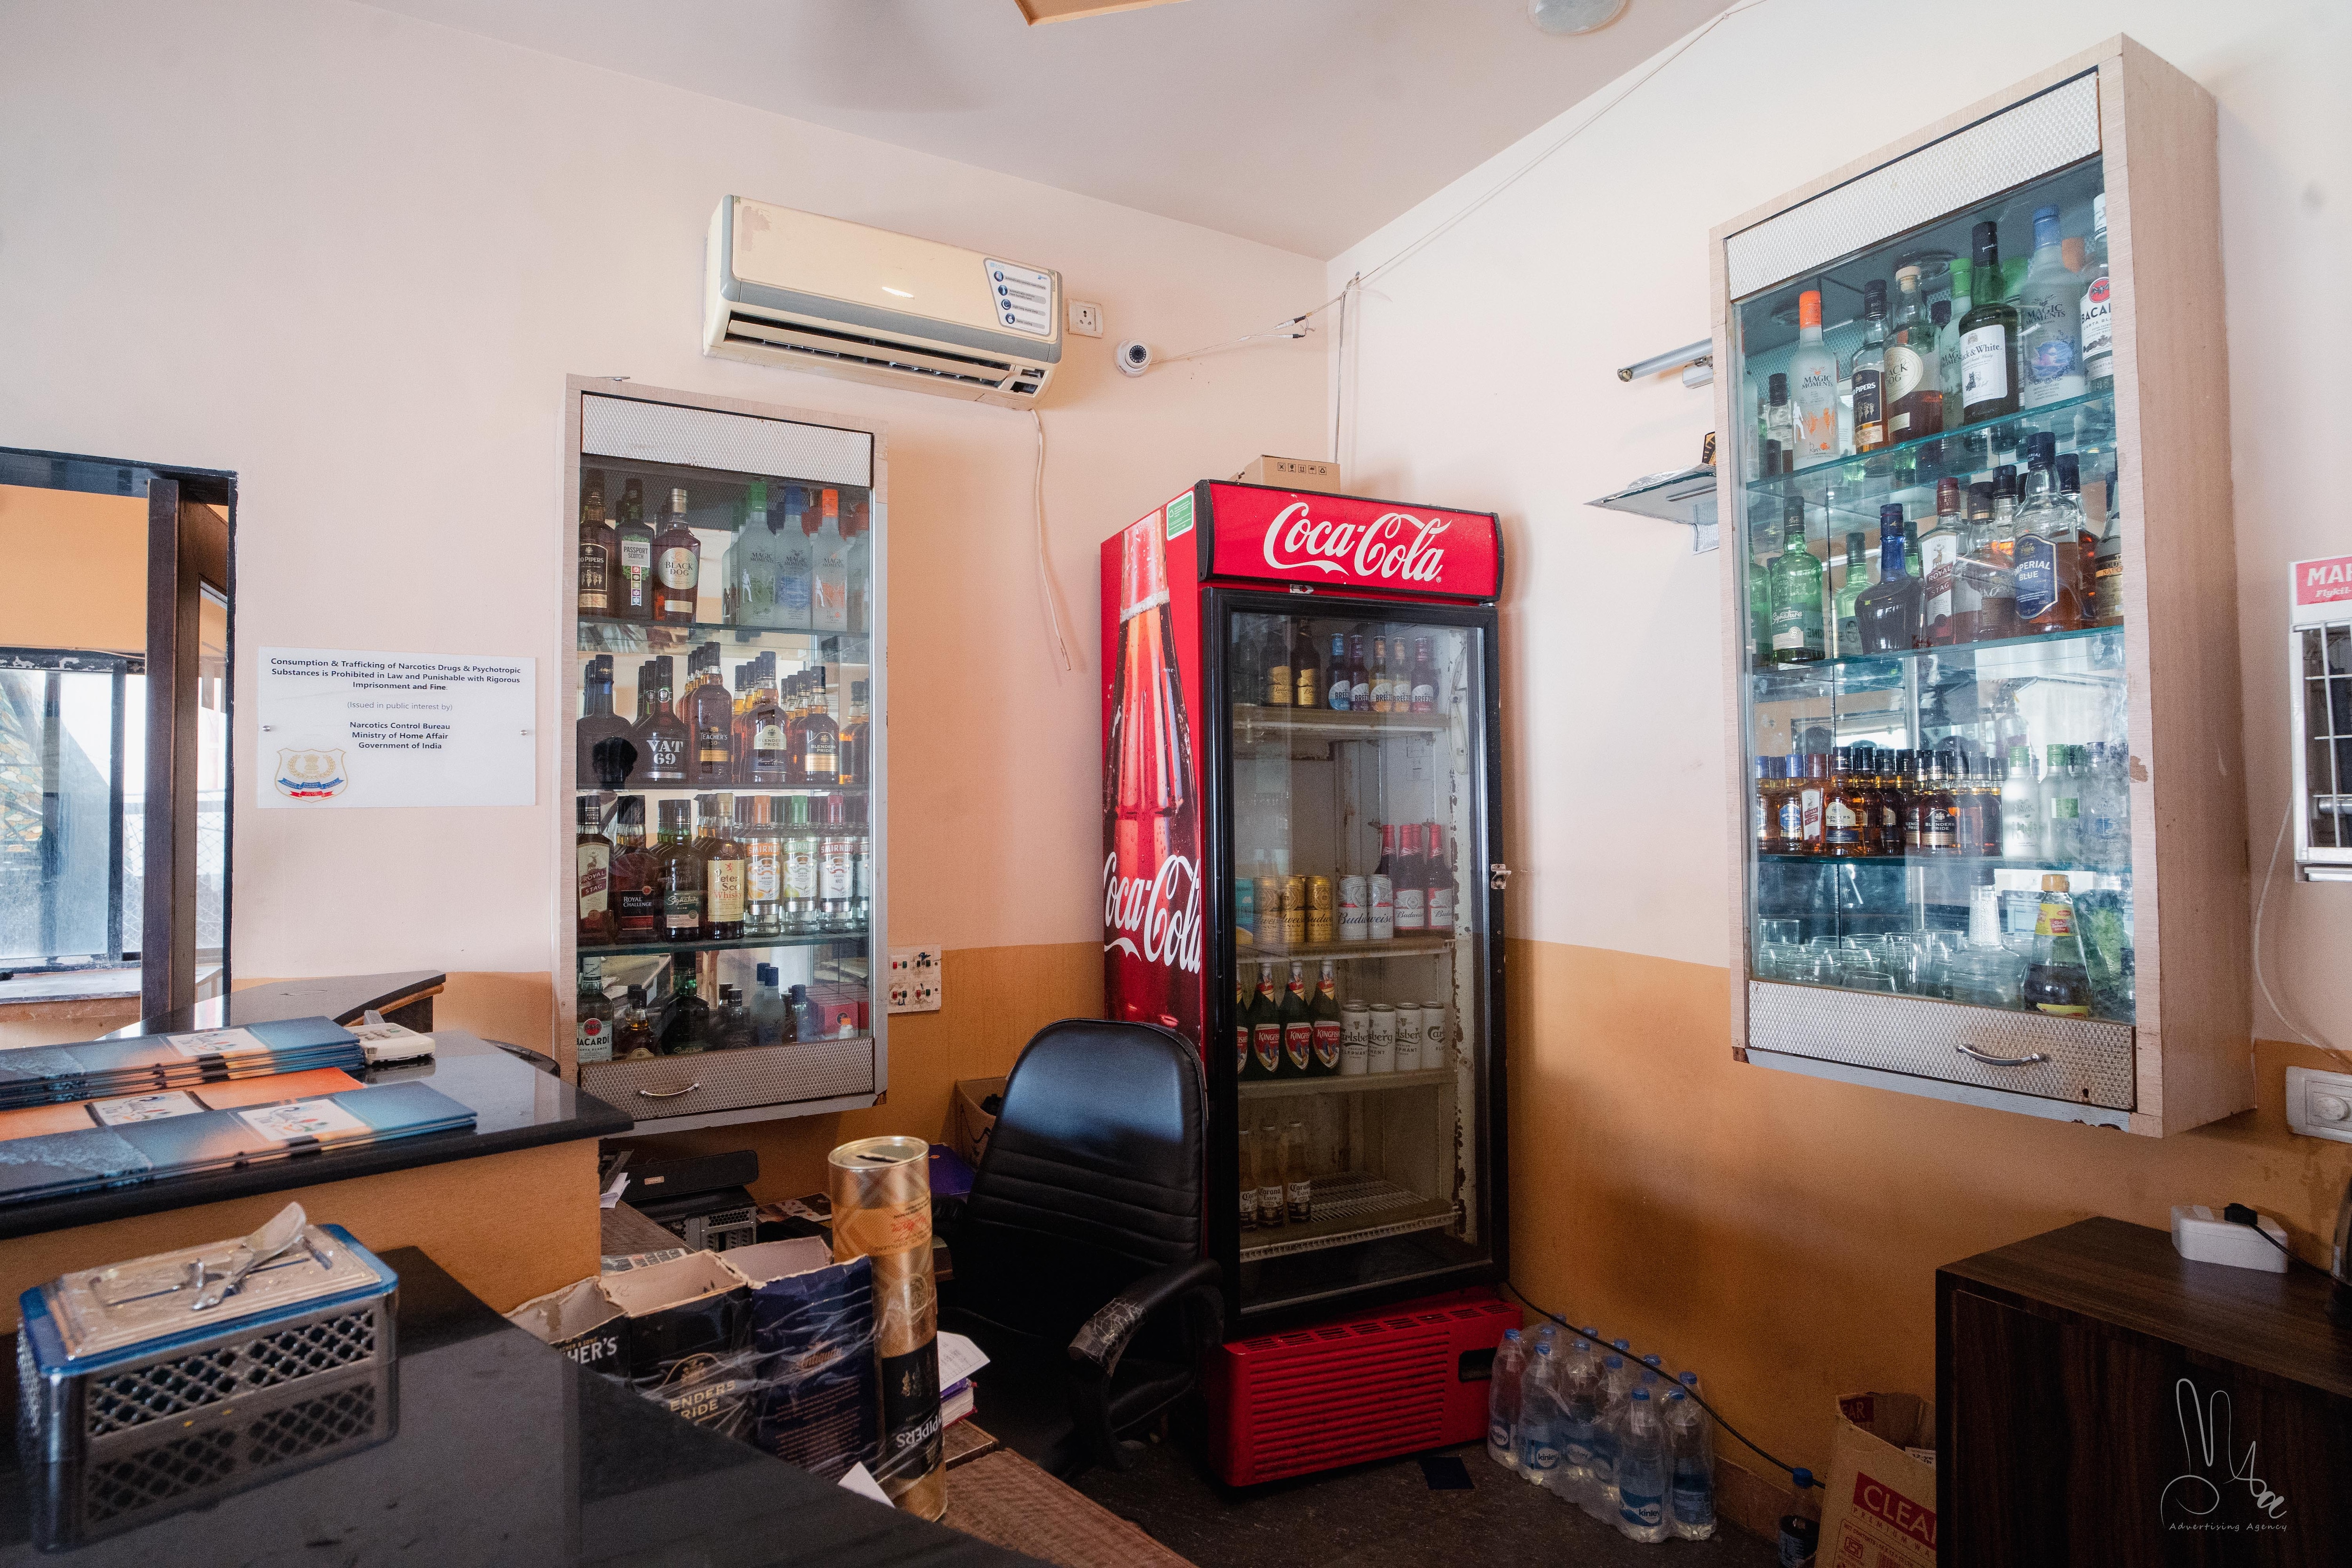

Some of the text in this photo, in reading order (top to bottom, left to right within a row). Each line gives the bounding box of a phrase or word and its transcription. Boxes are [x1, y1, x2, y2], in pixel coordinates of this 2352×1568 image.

[2026, 311, 2066, 325] MOMENTS
[2027, 304, 2063, 318] MAGIC
[1804, 375, 1831, 384] MAGIC
[1855, 382, 1876, 394] PIPERS
[1263, 502, 1452, 582] Coca-Cola
[666, 561, 693, 570] BLACK
[1929, 567, 1951, 581] ROYAL
[2019, 570, 2038, 581] BLUE
[1931, 581, 1949, 596] STAG
[1772, 611, 1803, 625] Signature
[270, 658, 328, 667] Consumption
[341, 660, 385, 670] Trafficking
[399, 662, 436, 670] Narcotics
[438, 664, 461, 673] Drugs
[472, 665, 521, 675] Psychotropic
[271, 669, 319, 677] Substances
[331, 670, 374, 678] Prohibited
[423, 673, 465, 682] Punishable
[486, 675, 520, 685] Rigorous
[353, 681, 410, 691] Imprisonment
[347, 701, 374, 710] (Issued
[386, 702, 410, 711] public
[441, 703, 453, 711] by)
[352, 732, 386, 740] Ministry
[647, 740, 683, 752] VAT
[654, 753, 675, 764] 69
[715, 868, 739, 883] Peter
[585, 883, 603, 894] STAG
[667, 895, 699, 906] Signature
[566, 1337, 618, 1364] HER'S
[668, 1379, 736, 1412] ENDERS
[680, 1399, 718, 1419] RIDE
[1638, 1508, 1660, 1518] kinley
[1853, 1507, 1907, 1544] PREMIUM
